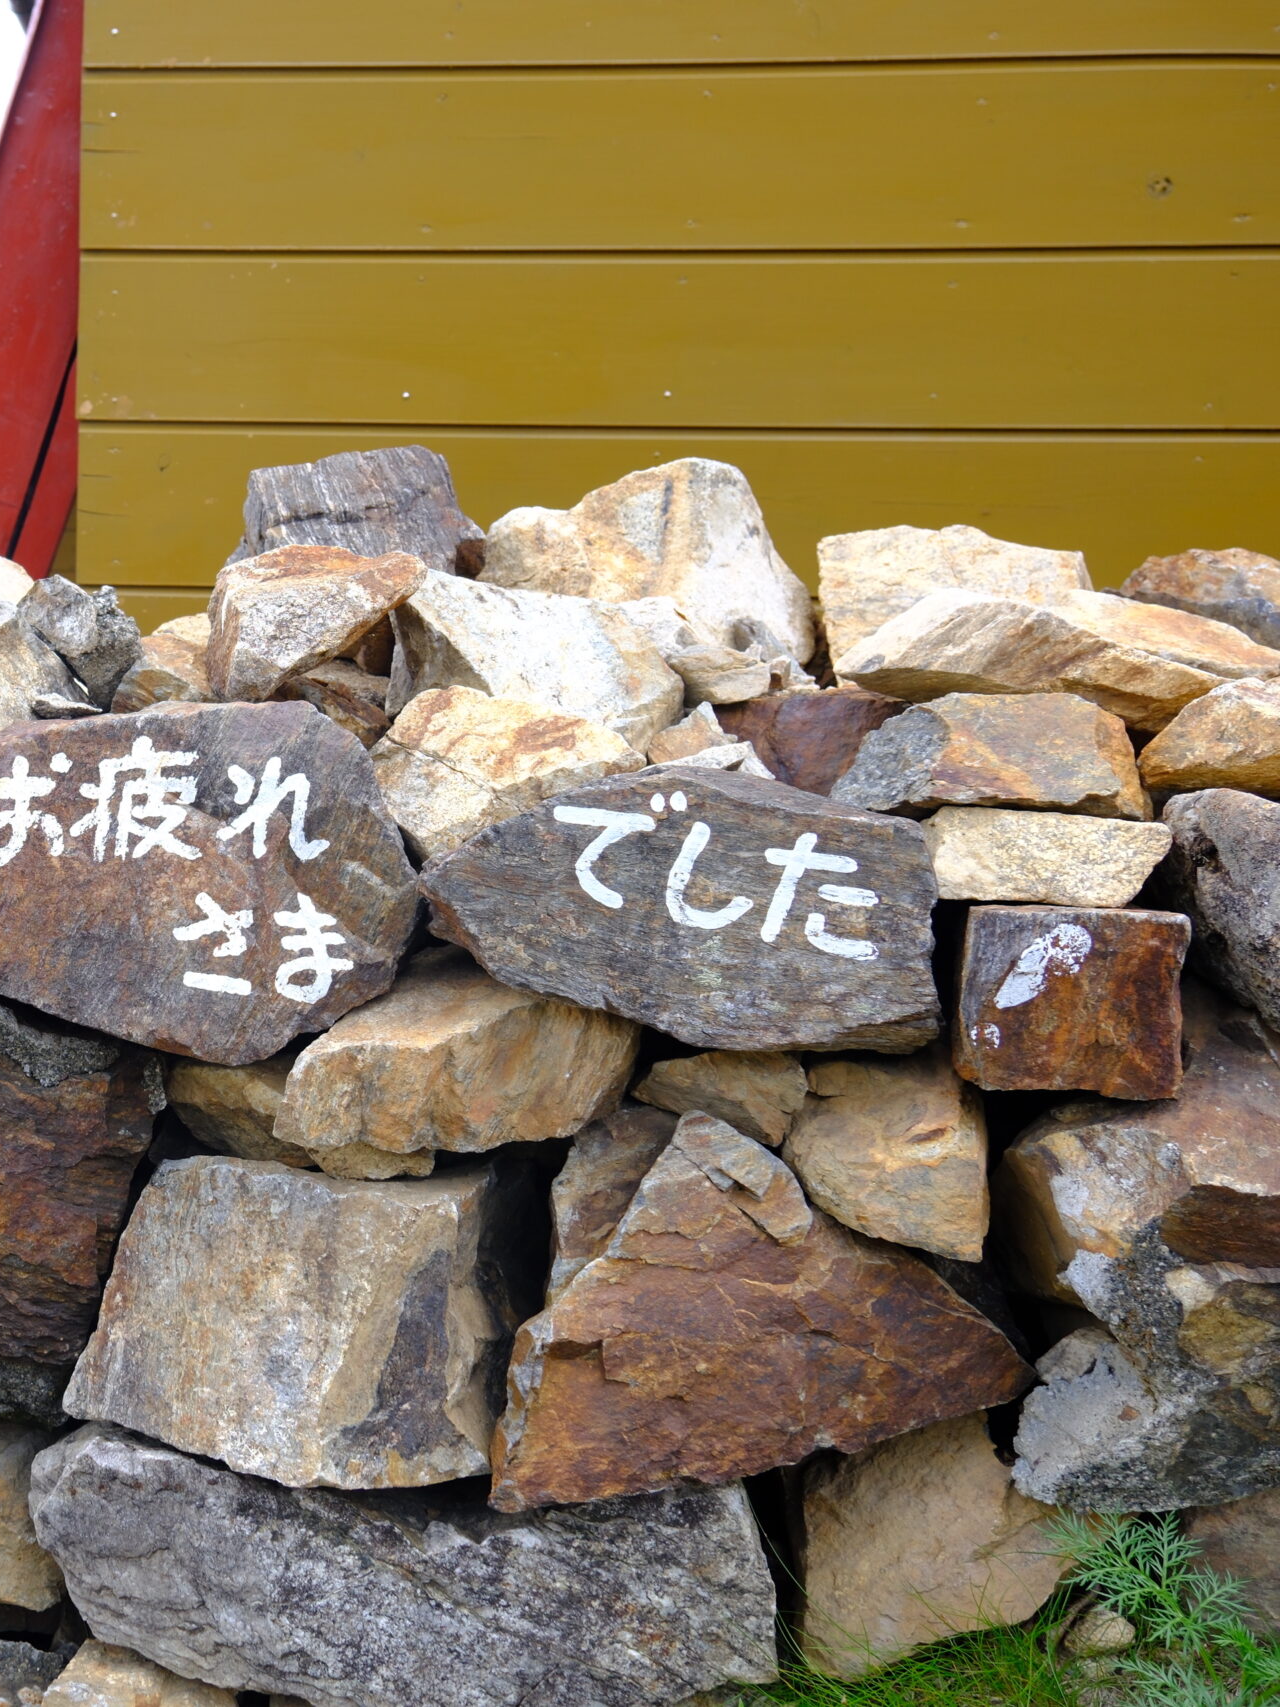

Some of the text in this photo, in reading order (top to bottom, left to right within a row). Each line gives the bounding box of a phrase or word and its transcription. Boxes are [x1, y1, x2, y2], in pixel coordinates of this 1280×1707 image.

[553, 790, 880, 961] でした
[172, 891, 354, 1004] さま
